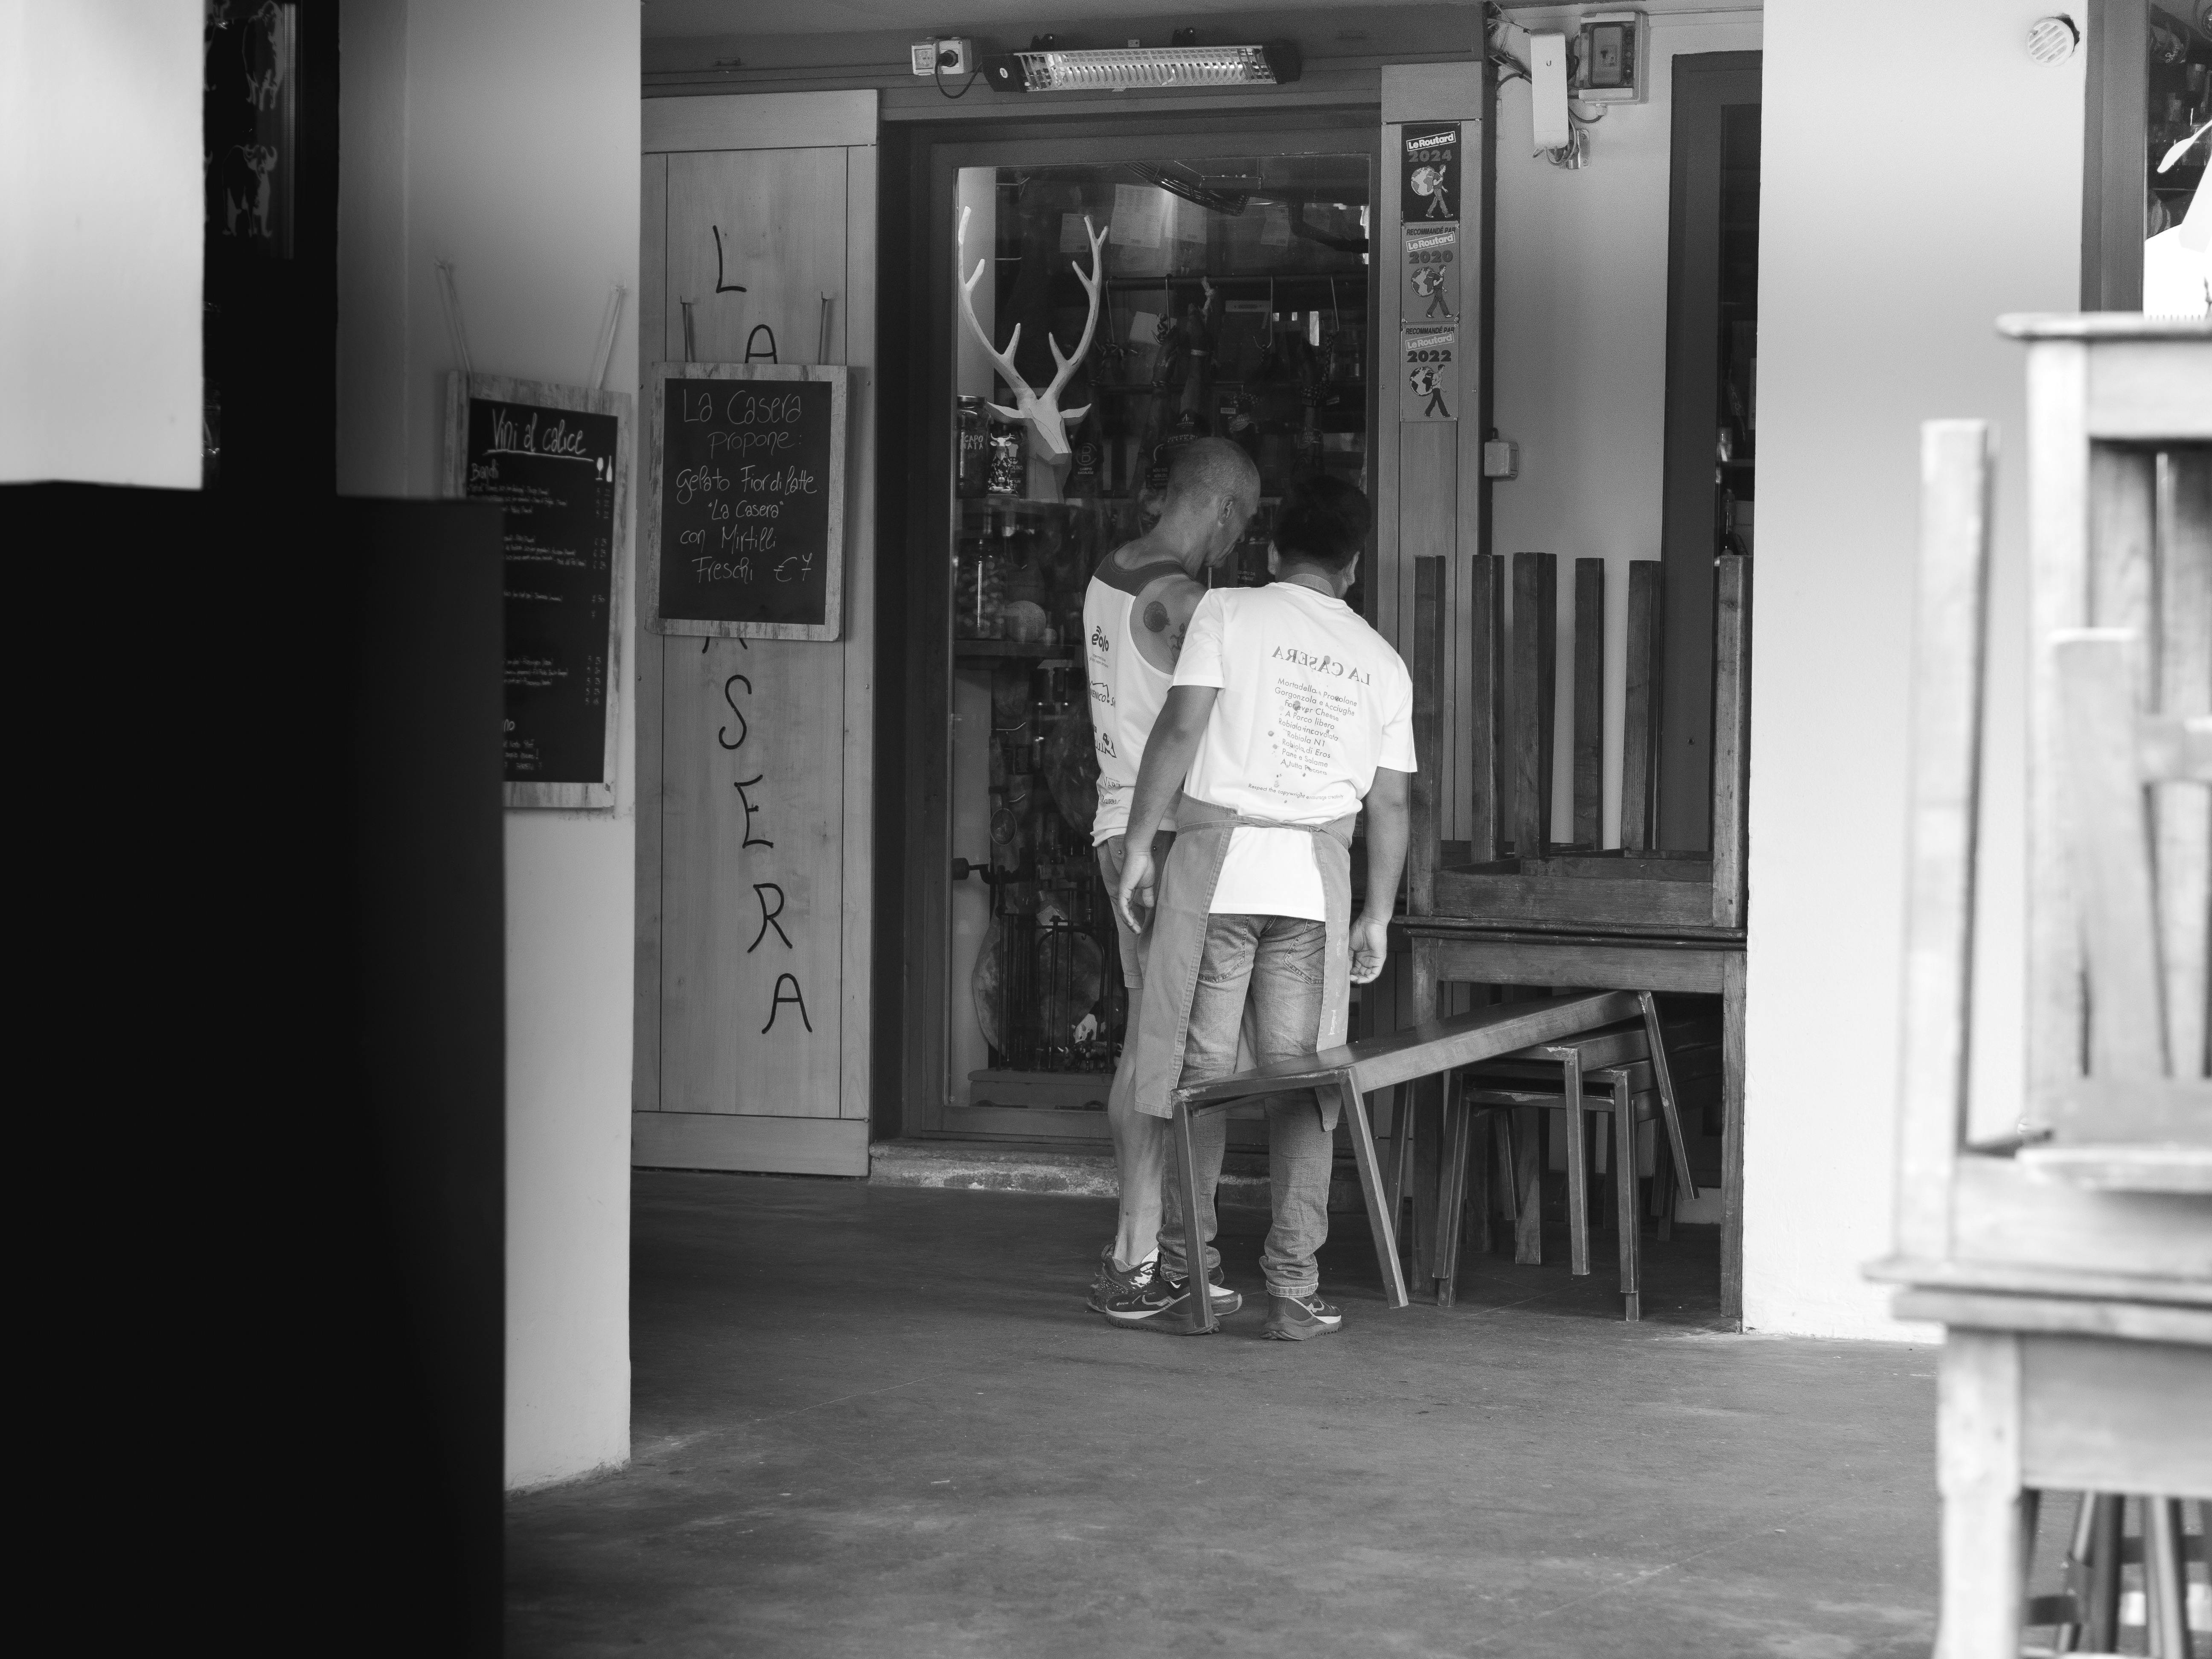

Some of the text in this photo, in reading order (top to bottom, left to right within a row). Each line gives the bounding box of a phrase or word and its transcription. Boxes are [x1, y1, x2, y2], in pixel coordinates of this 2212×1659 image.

[1408, 149, 1452, 163] 2024
[1406, 226, 1444, 236] RECOMMANDÉ
[1409, 250, 1453, 264] 2020
[1406, 326, 1443, 335] RECOMMANDÉ
[1406, 349, 1452, 362] 2022
[684, 389, 802, 425] La Casera
[542, 419, 586, 455] calice
[680, 524, 777, 554] con Mirtilli
[692, 556, 753, 584] Freschi
[1091, 633, 1109, 652] eolo
[1275, 687, 1317, 704] Gorgonzola
[1325, 702, 1355, 717] Acciughe
[1277, 678, 1358, 707] Mortadella Provolone
[1284, 699, 1339, 722] Forever Cheese
[1278, 717, 1339, 742] Robiola incavolata
[1292, 712, 1313, 724] Porco
[1315, 717, 1335, 730] libero
[1287, 731, 1311, 744] Robiola
[1282, 738, 1331, 759] Robiola di Eros
[1282, 748, 1297, 759] Pane
[1304, 755, 1328, 768] Salame
[1289, 760, 1303, 770] tutta
[1304, 765, 1328, 776] Pecora
[1248, 783, 1267, 792] Respect
[1278, 790, 1305, 799] copywright
